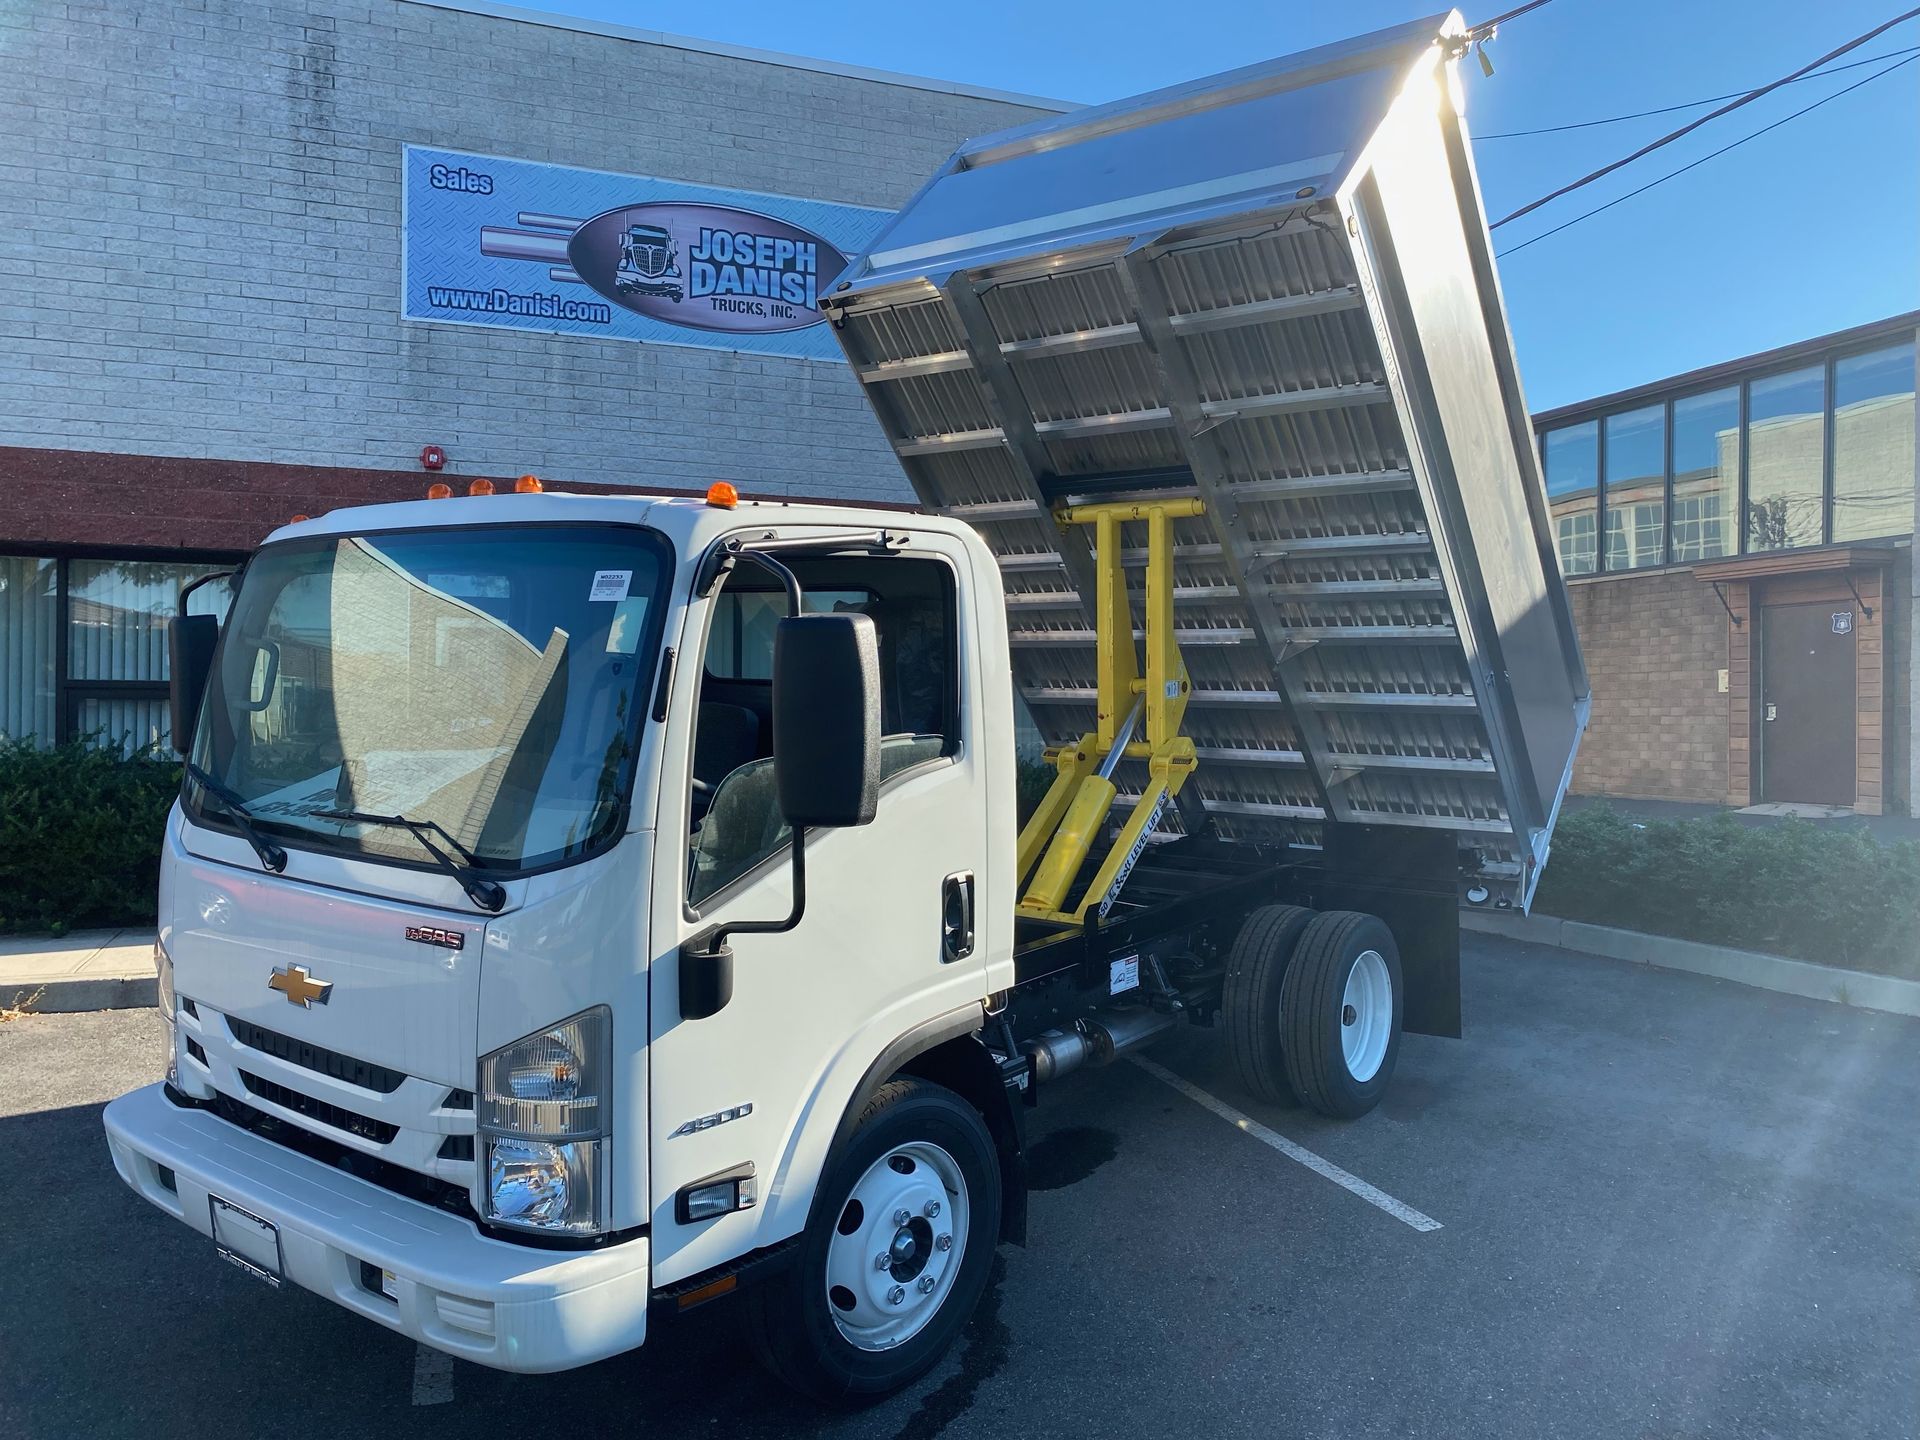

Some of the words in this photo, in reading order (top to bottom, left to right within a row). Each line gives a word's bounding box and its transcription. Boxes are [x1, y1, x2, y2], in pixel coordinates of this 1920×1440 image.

[431, 165, 493, 194] Sales
[691, 228, 817, 273] JOSEPH
[428, 286, 610, 323] www.Danisi.com
[690, 260, 817, 311] DANISI
[711, 298, 767, 318] TRUCKS,
[770, 304, 797, 319] INC.
[1115, 860, 1132, 888] Scott
[1131, 832, 1149, 860] LEVEL
[1147, 809, 1160, 833] LIFT
[666, 1102, 753, 1141] 4500
